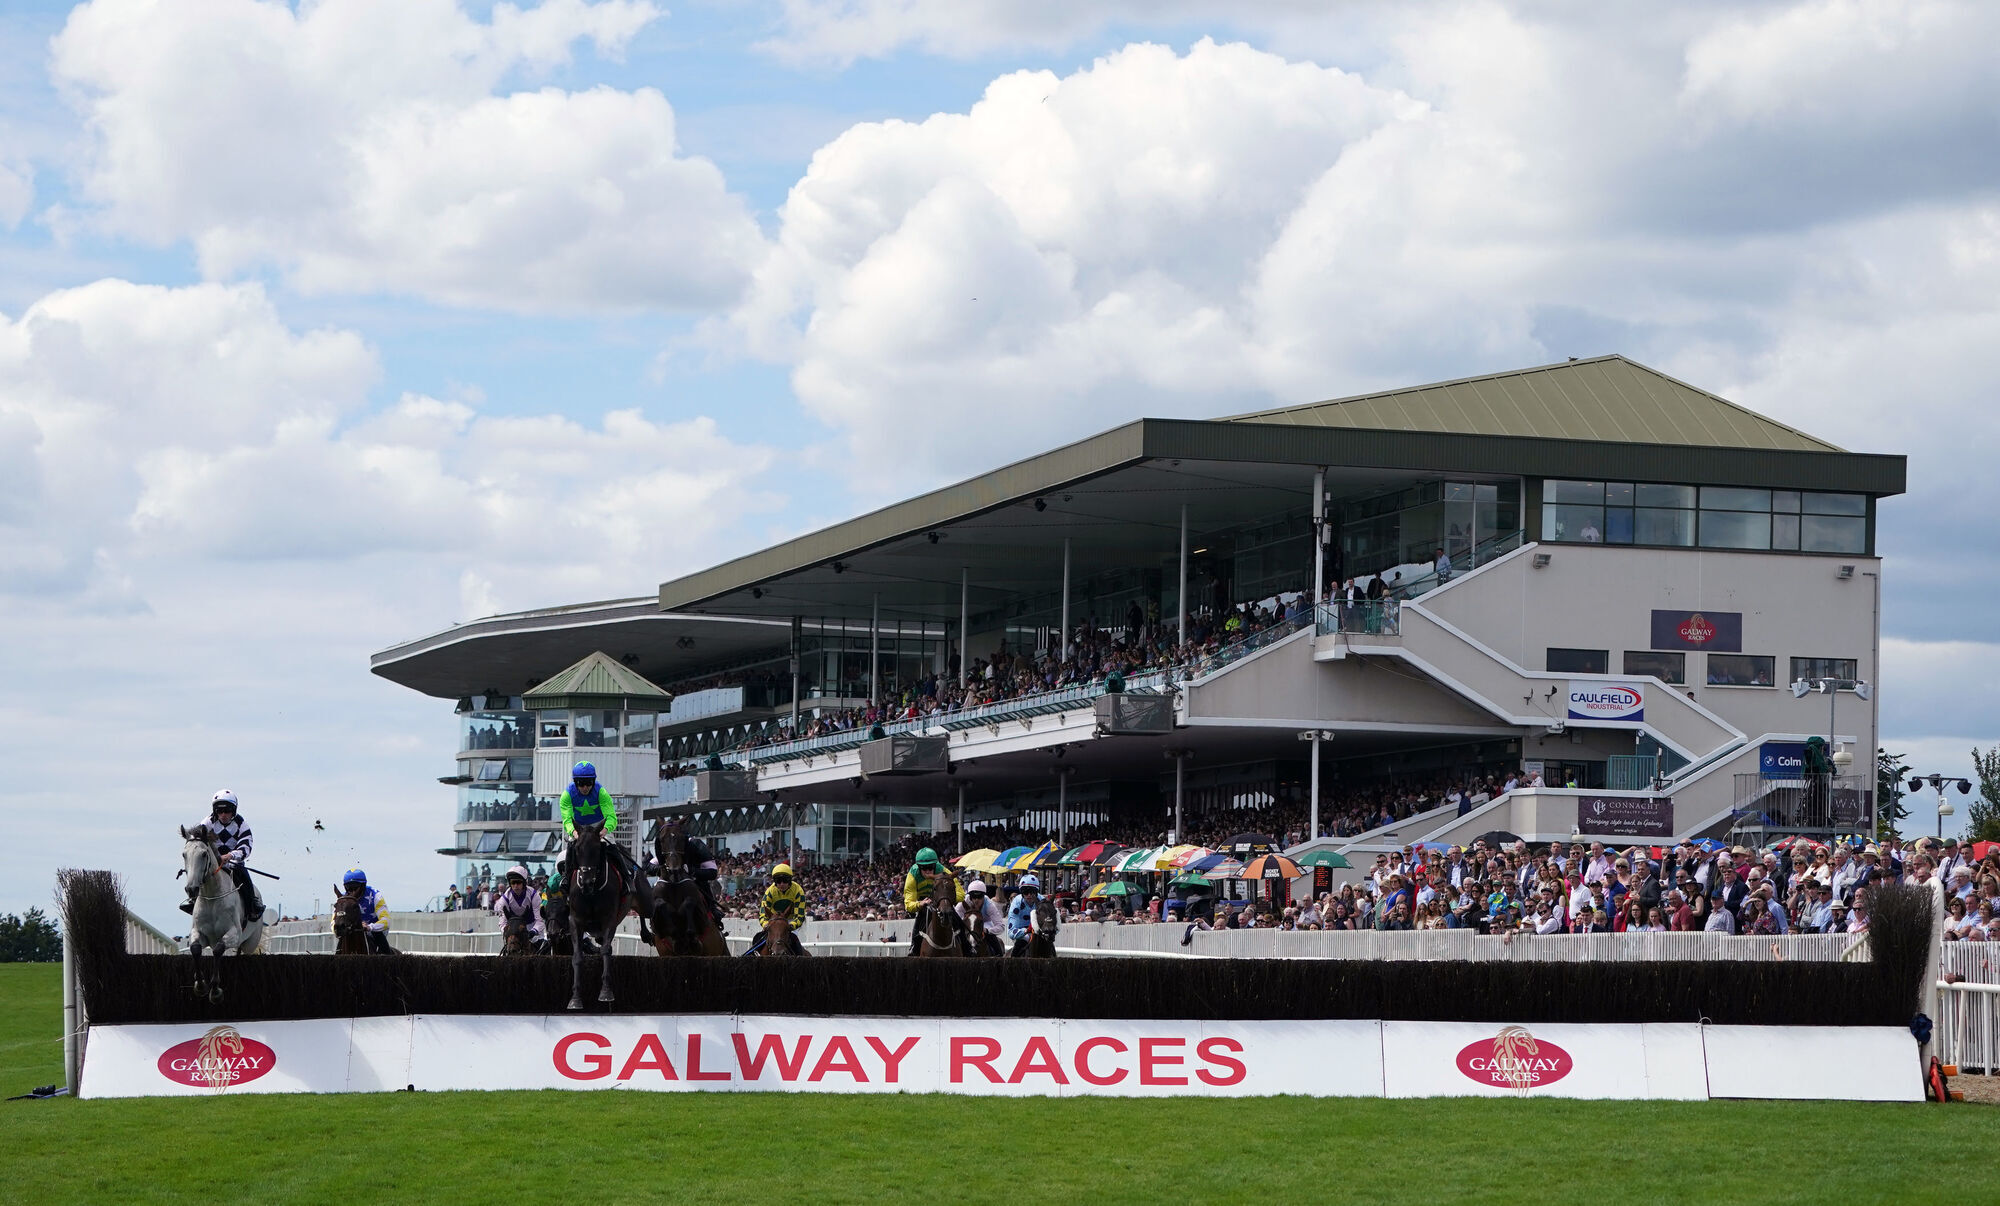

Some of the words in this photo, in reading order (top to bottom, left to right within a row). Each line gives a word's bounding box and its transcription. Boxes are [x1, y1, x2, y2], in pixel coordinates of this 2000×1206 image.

[1680, 628, 1713, 636] GALWAY
[1570, 693, 1633, 704] CAULFIELD
[1586, 703, 1625, 711] INDUSTRIAL
[1778, 756, 1802, 767] Colm
[1609, 801, 1659, 810] CONNACHT
[1585, 817, 1609, 826] Bringing
[1643, 818, 1664, 828] Galway
[170, 1056, 264, 1071] GALWAY
[553, 1033, 920, 1082] GALWAY
[950, 1037, 1246, 1086] RACES
[1469, 1057, 1560, 1071] GALWAY
[189, 1071, 241, 1081] RACES
[1490, 1071, 1541, 1082] RACES
